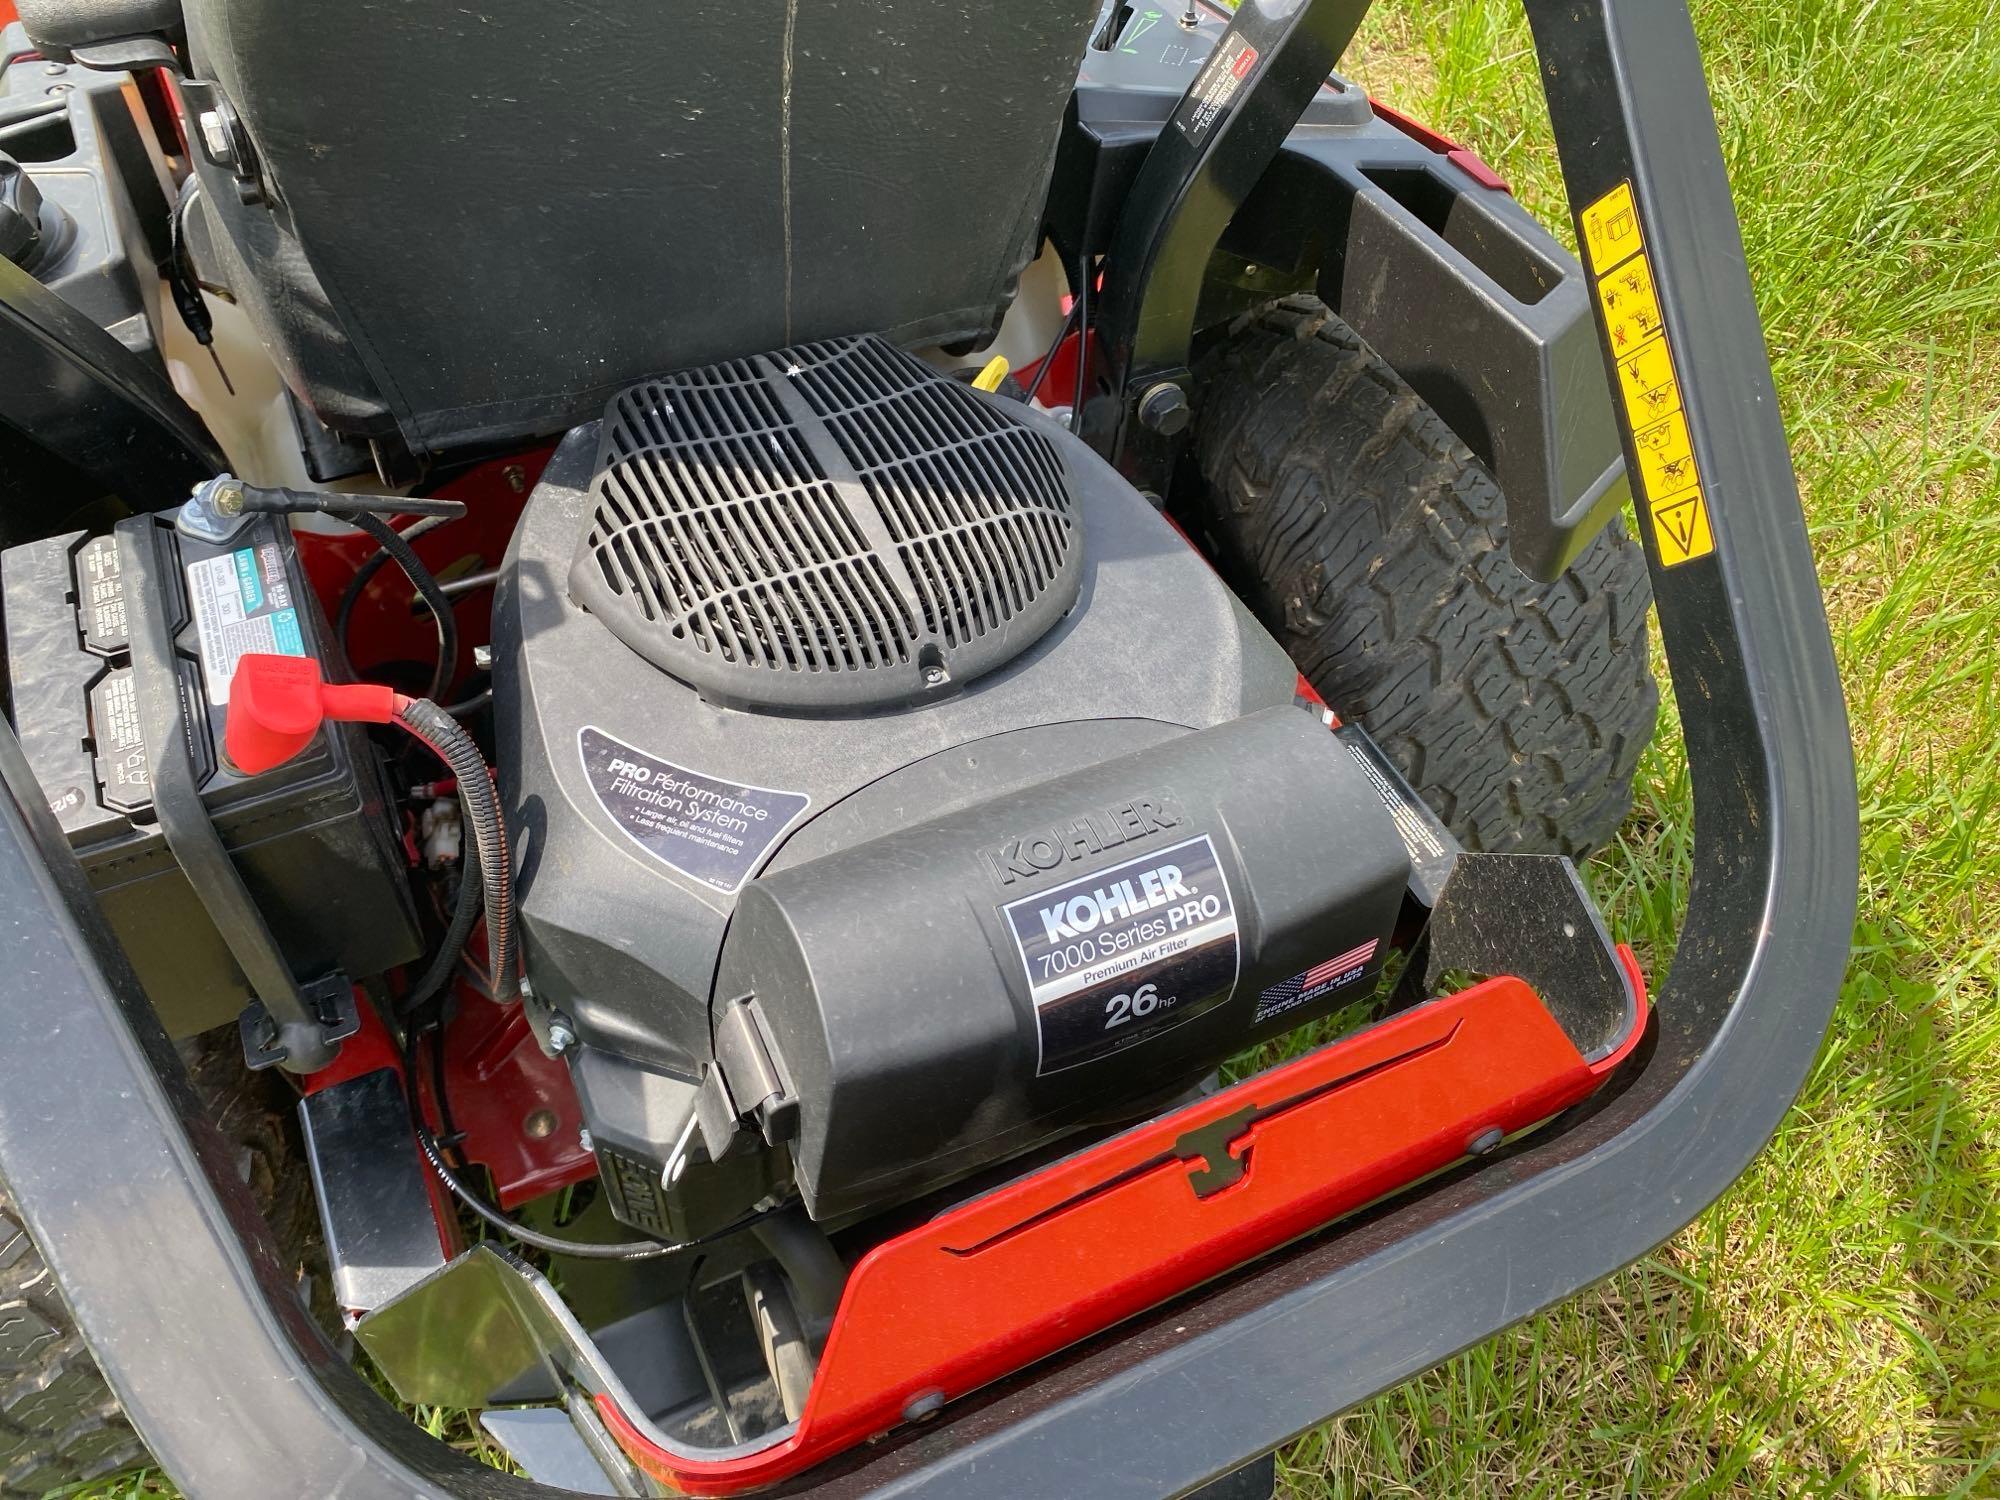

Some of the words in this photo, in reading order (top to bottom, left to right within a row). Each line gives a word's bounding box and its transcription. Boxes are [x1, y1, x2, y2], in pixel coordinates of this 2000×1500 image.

[237, 552, 249, 572] LAWN
[242, 576, 256, 603] GARDEN
[607, 758, 651, 782] PRO
[651, 771, 769, 821] Performance
[610, 778, 683, 812] Filtration
[685, 803, 749, 834] System
[635, 816, 653, 828] Less
[655, 819, 689, 840] frequent
[689, 832, 739, 855] maintenance
[640, 805, 666, 822] Larger
[679, 816, 689, 828] oil
[689, 821, 705, 834] and
[705, 826, 720, 839] fuel
[720, 831, 744, 846] filters
[986, 800, 1177, 886] KOHLER
[1039, 864, 1194, 945] KOHLER
[1038, 941, 1096, 979] 7000
[1099, 918, 1166, 957] Series
[1168, 894, 1221, 931] PRO
[1083, 955, 1138, 984] Premium
[1139, 949, 1157, 963] Air
[1159, 937, 1189, 958] Filter
[1104, 982, 1158, 1030] 26
[1158, 994, 1177, 1009] hp
[1256, 999, 1296, 1018] ENGINE
[1298, 983, 1324, 999] MADE
[1327, 977, 1341, 988] IN
[1342, 965, 1365, 981] USA
[1285, 998, 1303, 1012] AND
[1305, 985, 1336, 1004] GLOBAL
[1337, 971, 1363, 989] PARTS
